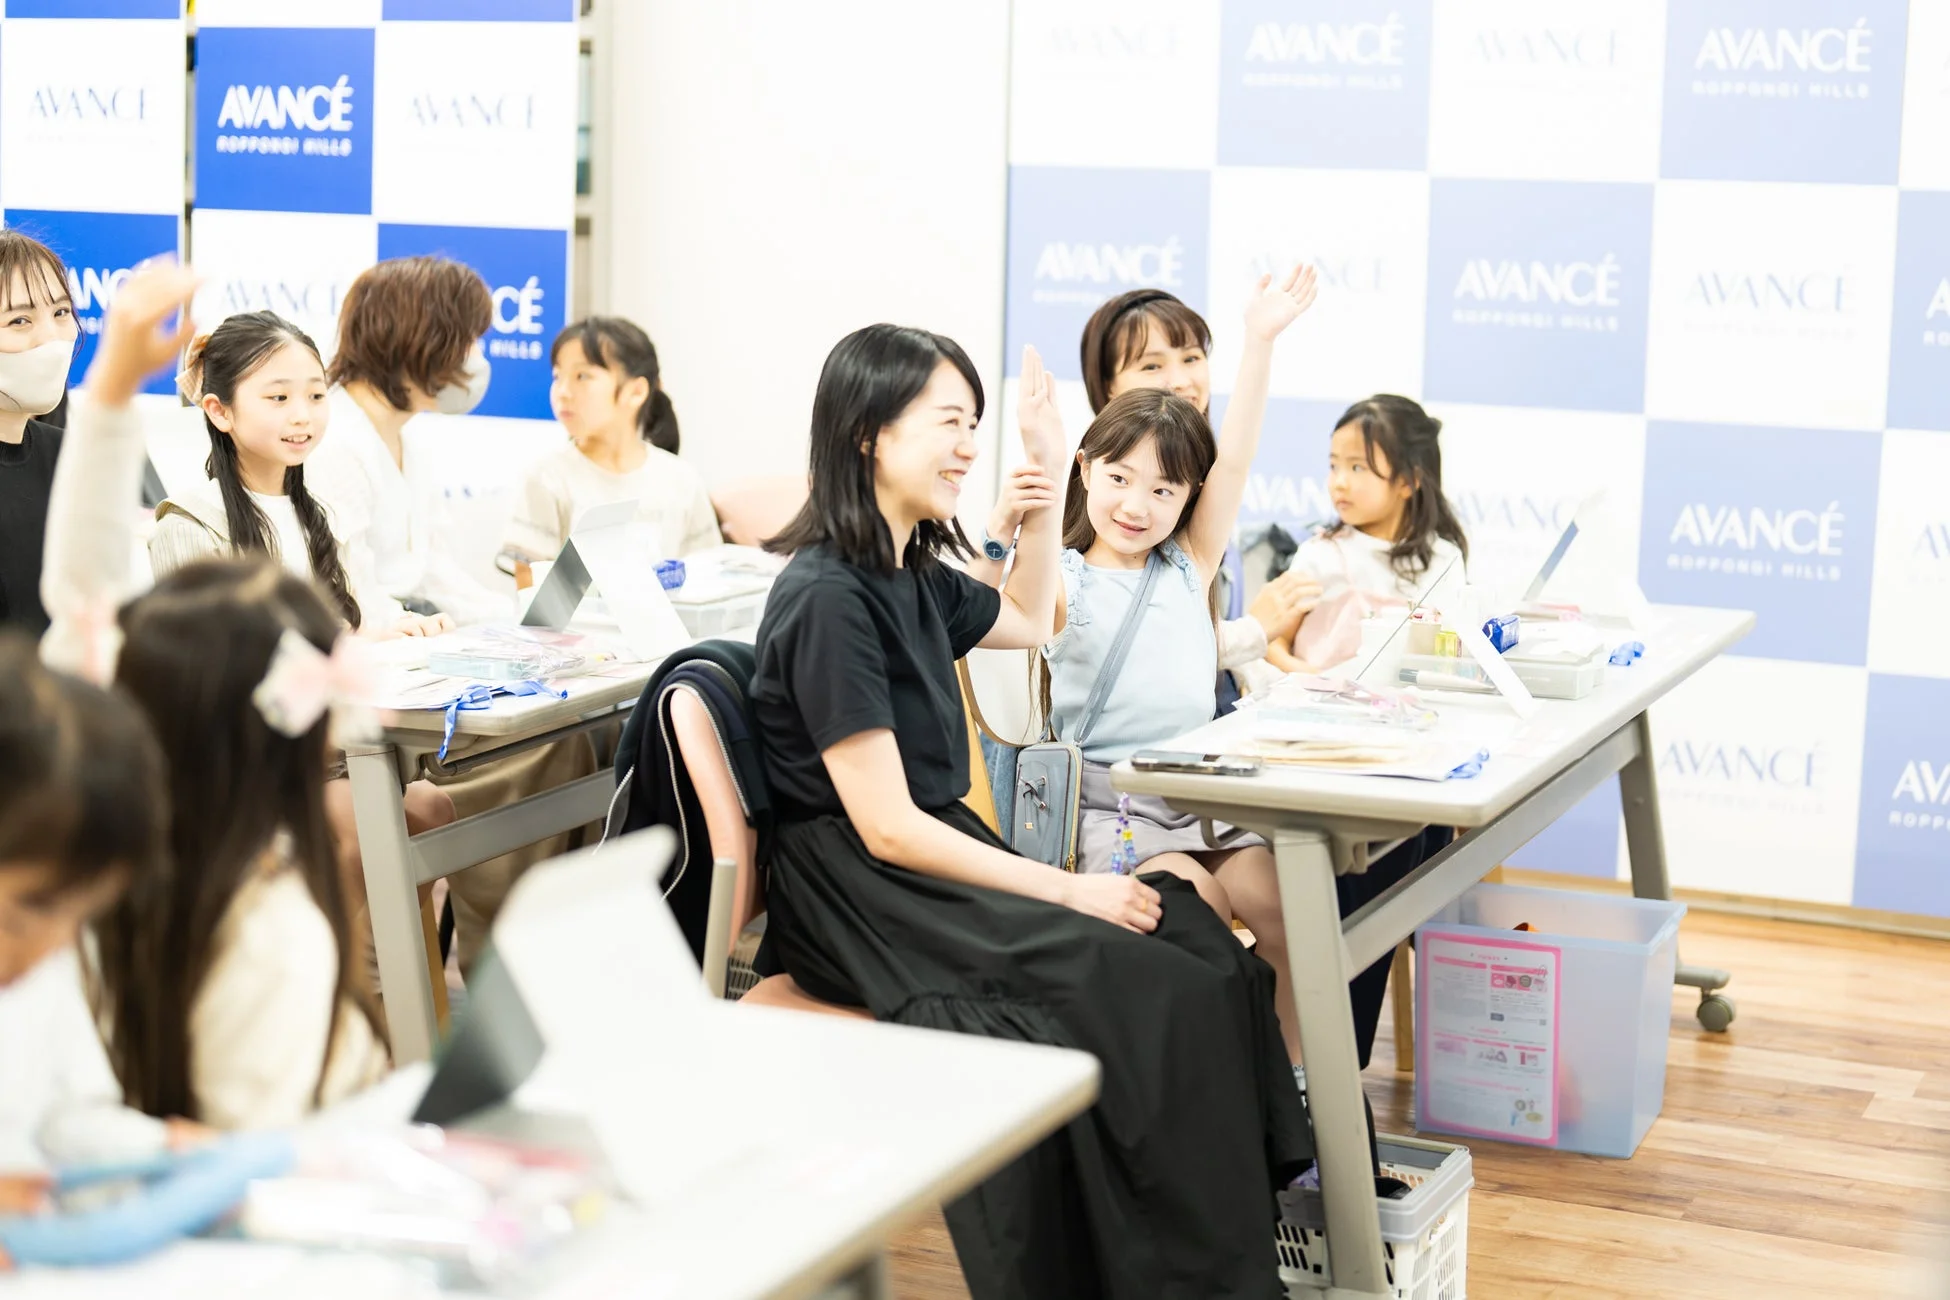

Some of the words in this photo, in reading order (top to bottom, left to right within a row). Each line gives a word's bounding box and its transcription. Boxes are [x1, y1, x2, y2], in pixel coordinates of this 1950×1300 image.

[1245, 11, 1405, 66] AVANCÉ
[1694, 15, 1873, 73] AVANCÉ
[217, 74, 353, 132] AVANCÉ
[1034, 235, 1184, 287] AVANCÉ
[1454, 251, 1621, 307] AVANCÉ
[1670, 500, 1845, 556] AVANCÉ
